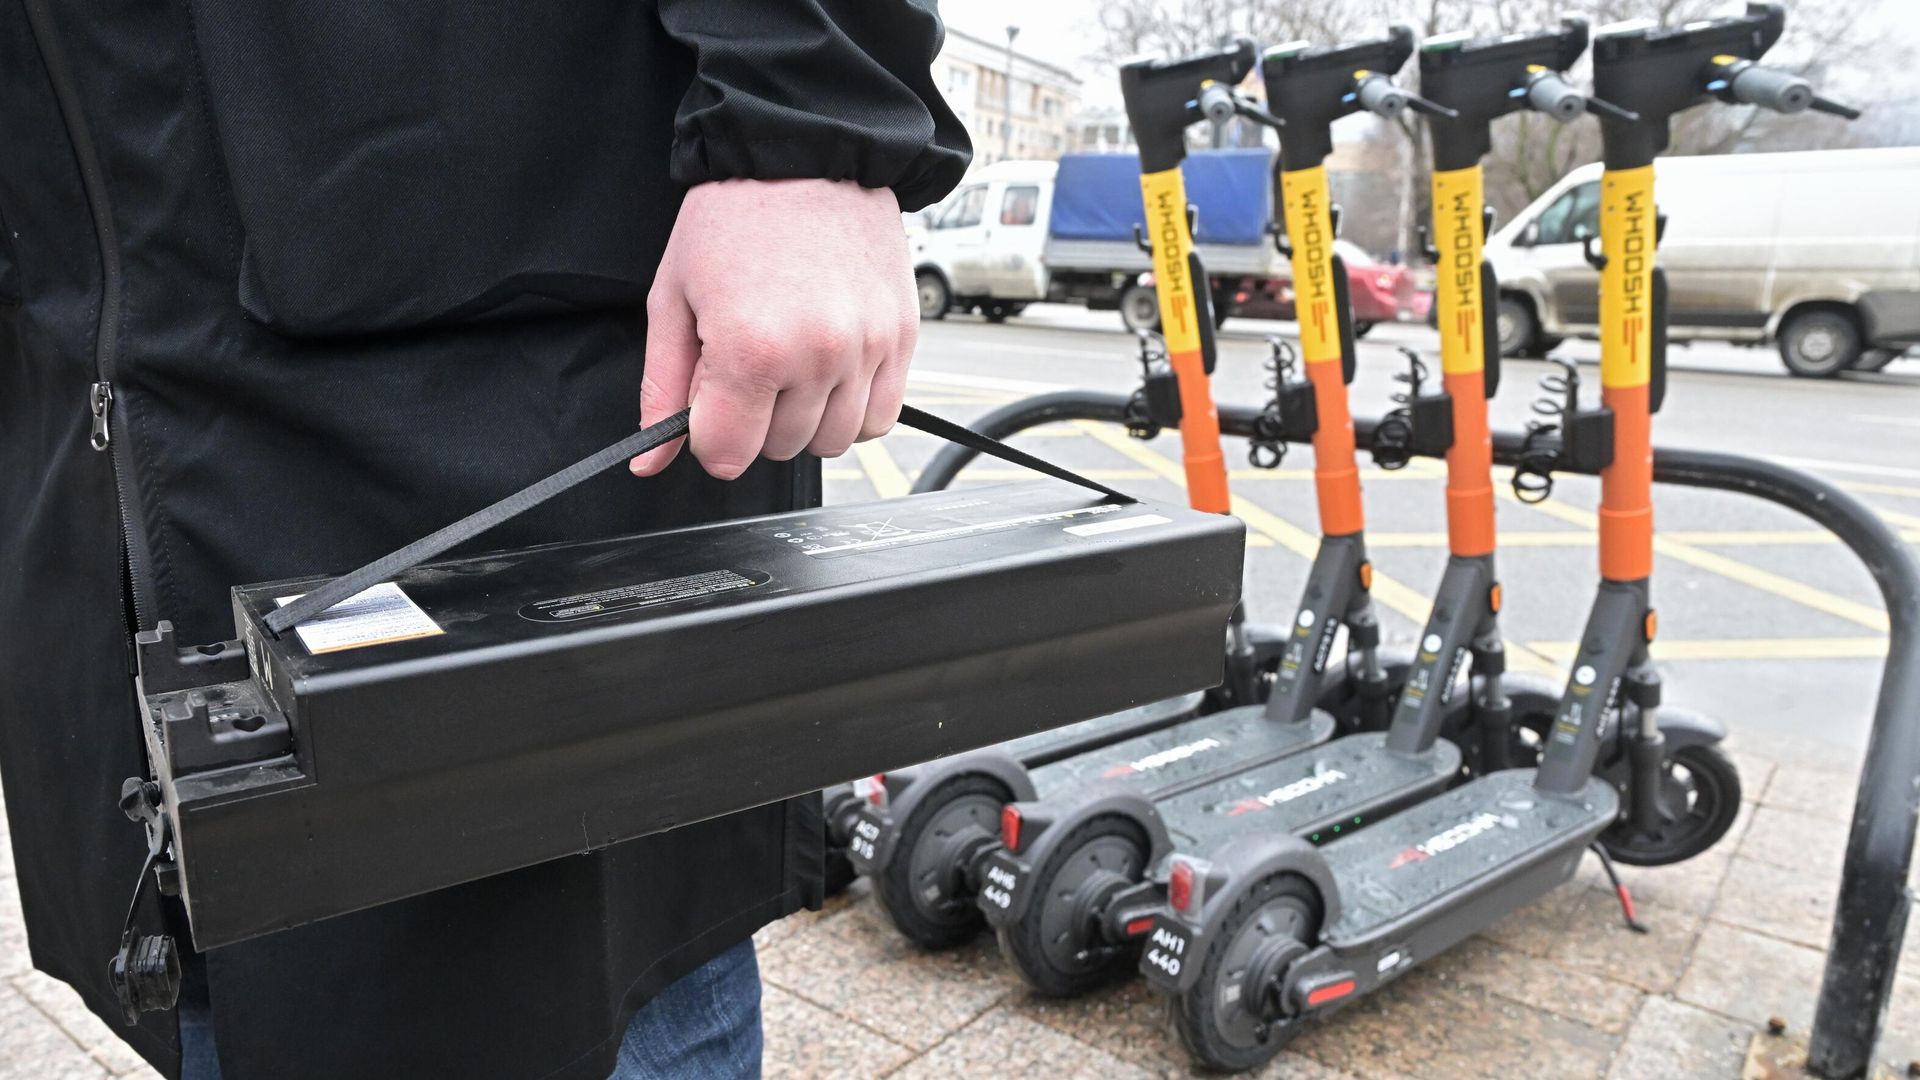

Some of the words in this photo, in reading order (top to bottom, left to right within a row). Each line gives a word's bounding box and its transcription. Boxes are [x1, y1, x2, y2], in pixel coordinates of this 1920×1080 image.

[1157, 188, 1184, 292] WHOOSH
[1301, 189, 1327, 298] WHOOSH
[1453, 191, 1475, 306] WHOOSH
[1623, 189, 1645, 314] WHOOSH
[1147, 948, 1181, 976] 440
[1152, 927, 1185, 955] AH1
